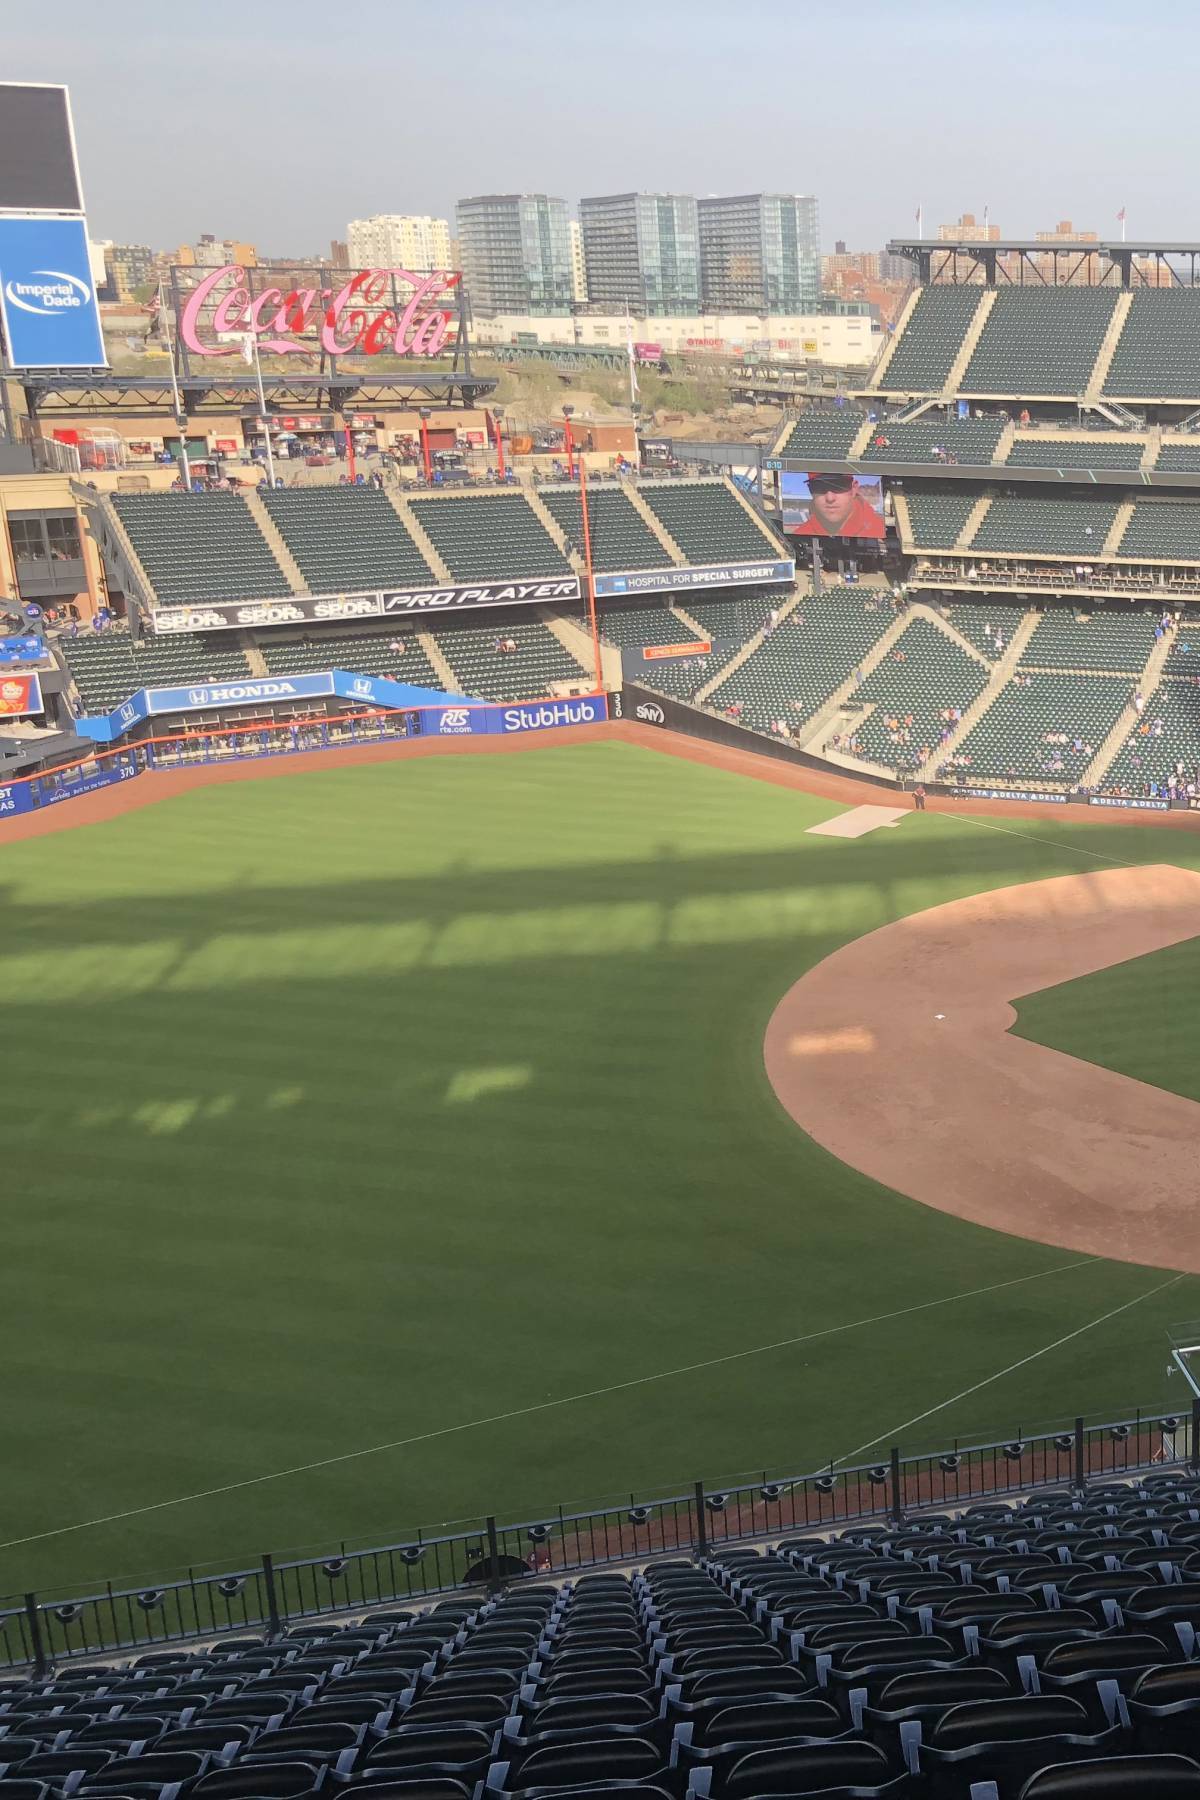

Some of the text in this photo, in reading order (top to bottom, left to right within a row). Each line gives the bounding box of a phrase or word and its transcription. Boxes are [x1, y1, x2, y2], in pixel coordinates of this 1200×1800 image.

[16, 282, 73, 297] Imperial
[43, 294, 80, 306] Dade
[628, 575, 671, 587] HOSPITAL
[673, 574, 690, 584] FOR
[692, 571, 731, 582] SPECIAL
[733, 568, 774, 579] SURGERY
[386, 582, 576, 609] PRO PLAYER
[210, 682, 297, 701] HONDA
[440, 709, 470, 727] RTS
[504, 702, 594, 731] StubHub
[636, 705, 660, 722] SNY
[120, 766, 134, 779] 370
[1000, 791, 1027, 799] DELTA
[1039, 794, 1066, 802] DELTA
